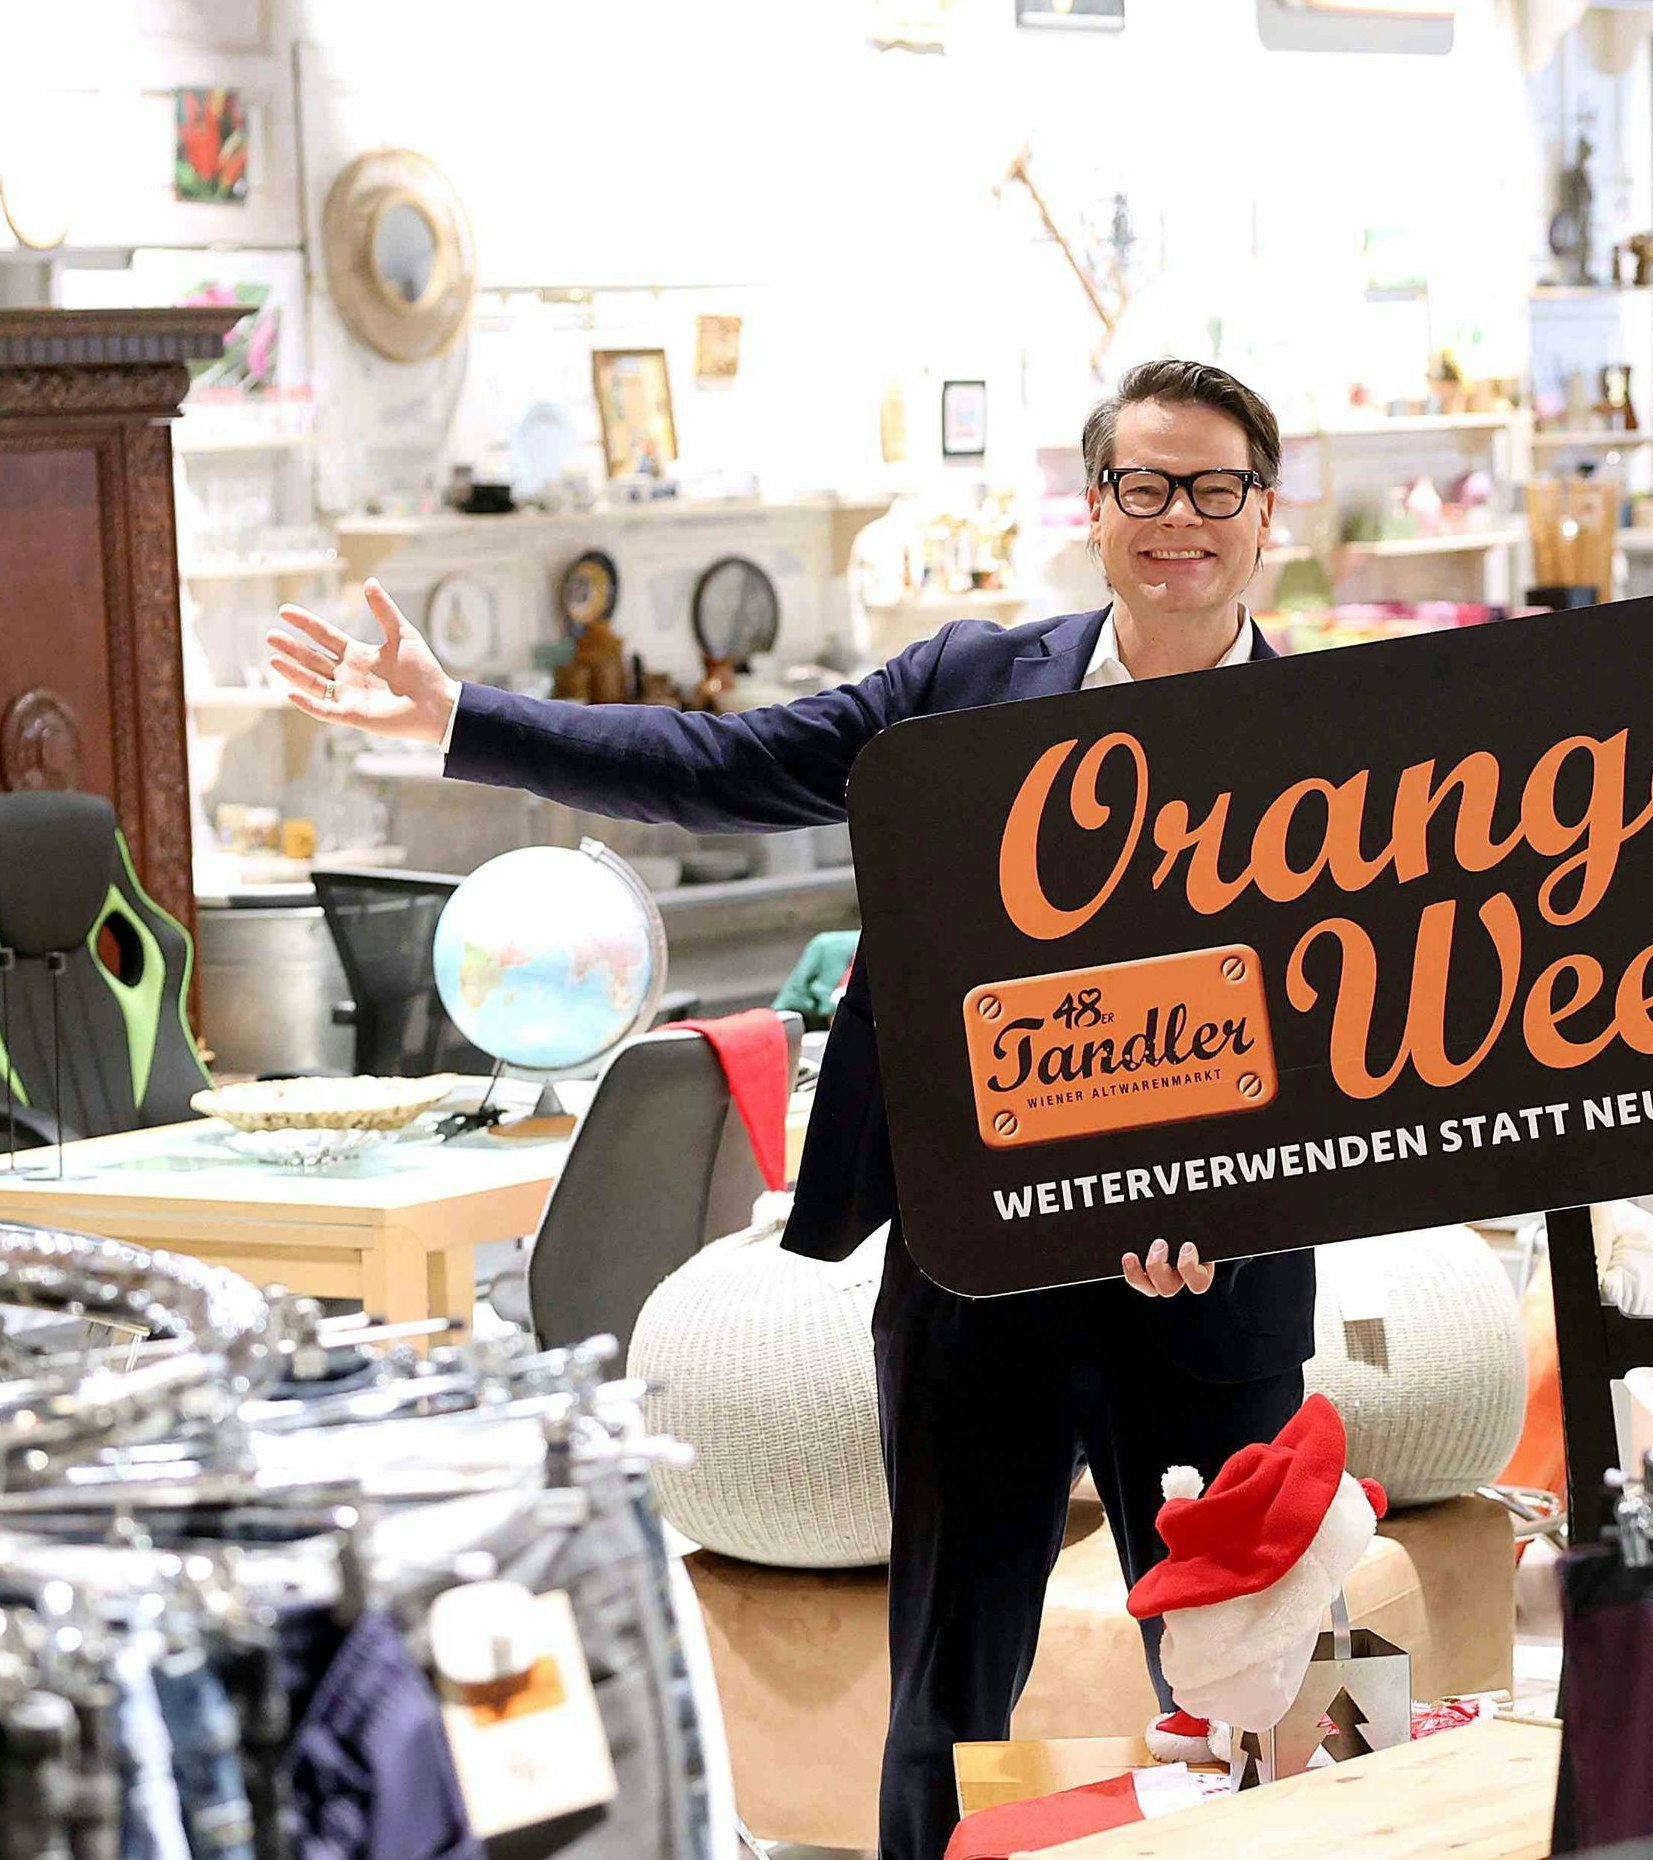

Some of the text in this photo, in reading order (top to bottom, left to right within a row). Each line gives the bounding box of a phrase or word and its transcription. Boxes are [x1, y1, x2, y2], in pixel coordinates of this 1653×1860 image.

[987, 1002, 1256, 1093] Tandler
[1026, 1068, 1222, 1109] WIENER ALTWARENMARKT
[992, 1124, 1429, 1222] WEITERVERWENDEN
[1438, 1102, 1571, 1153] STATT
